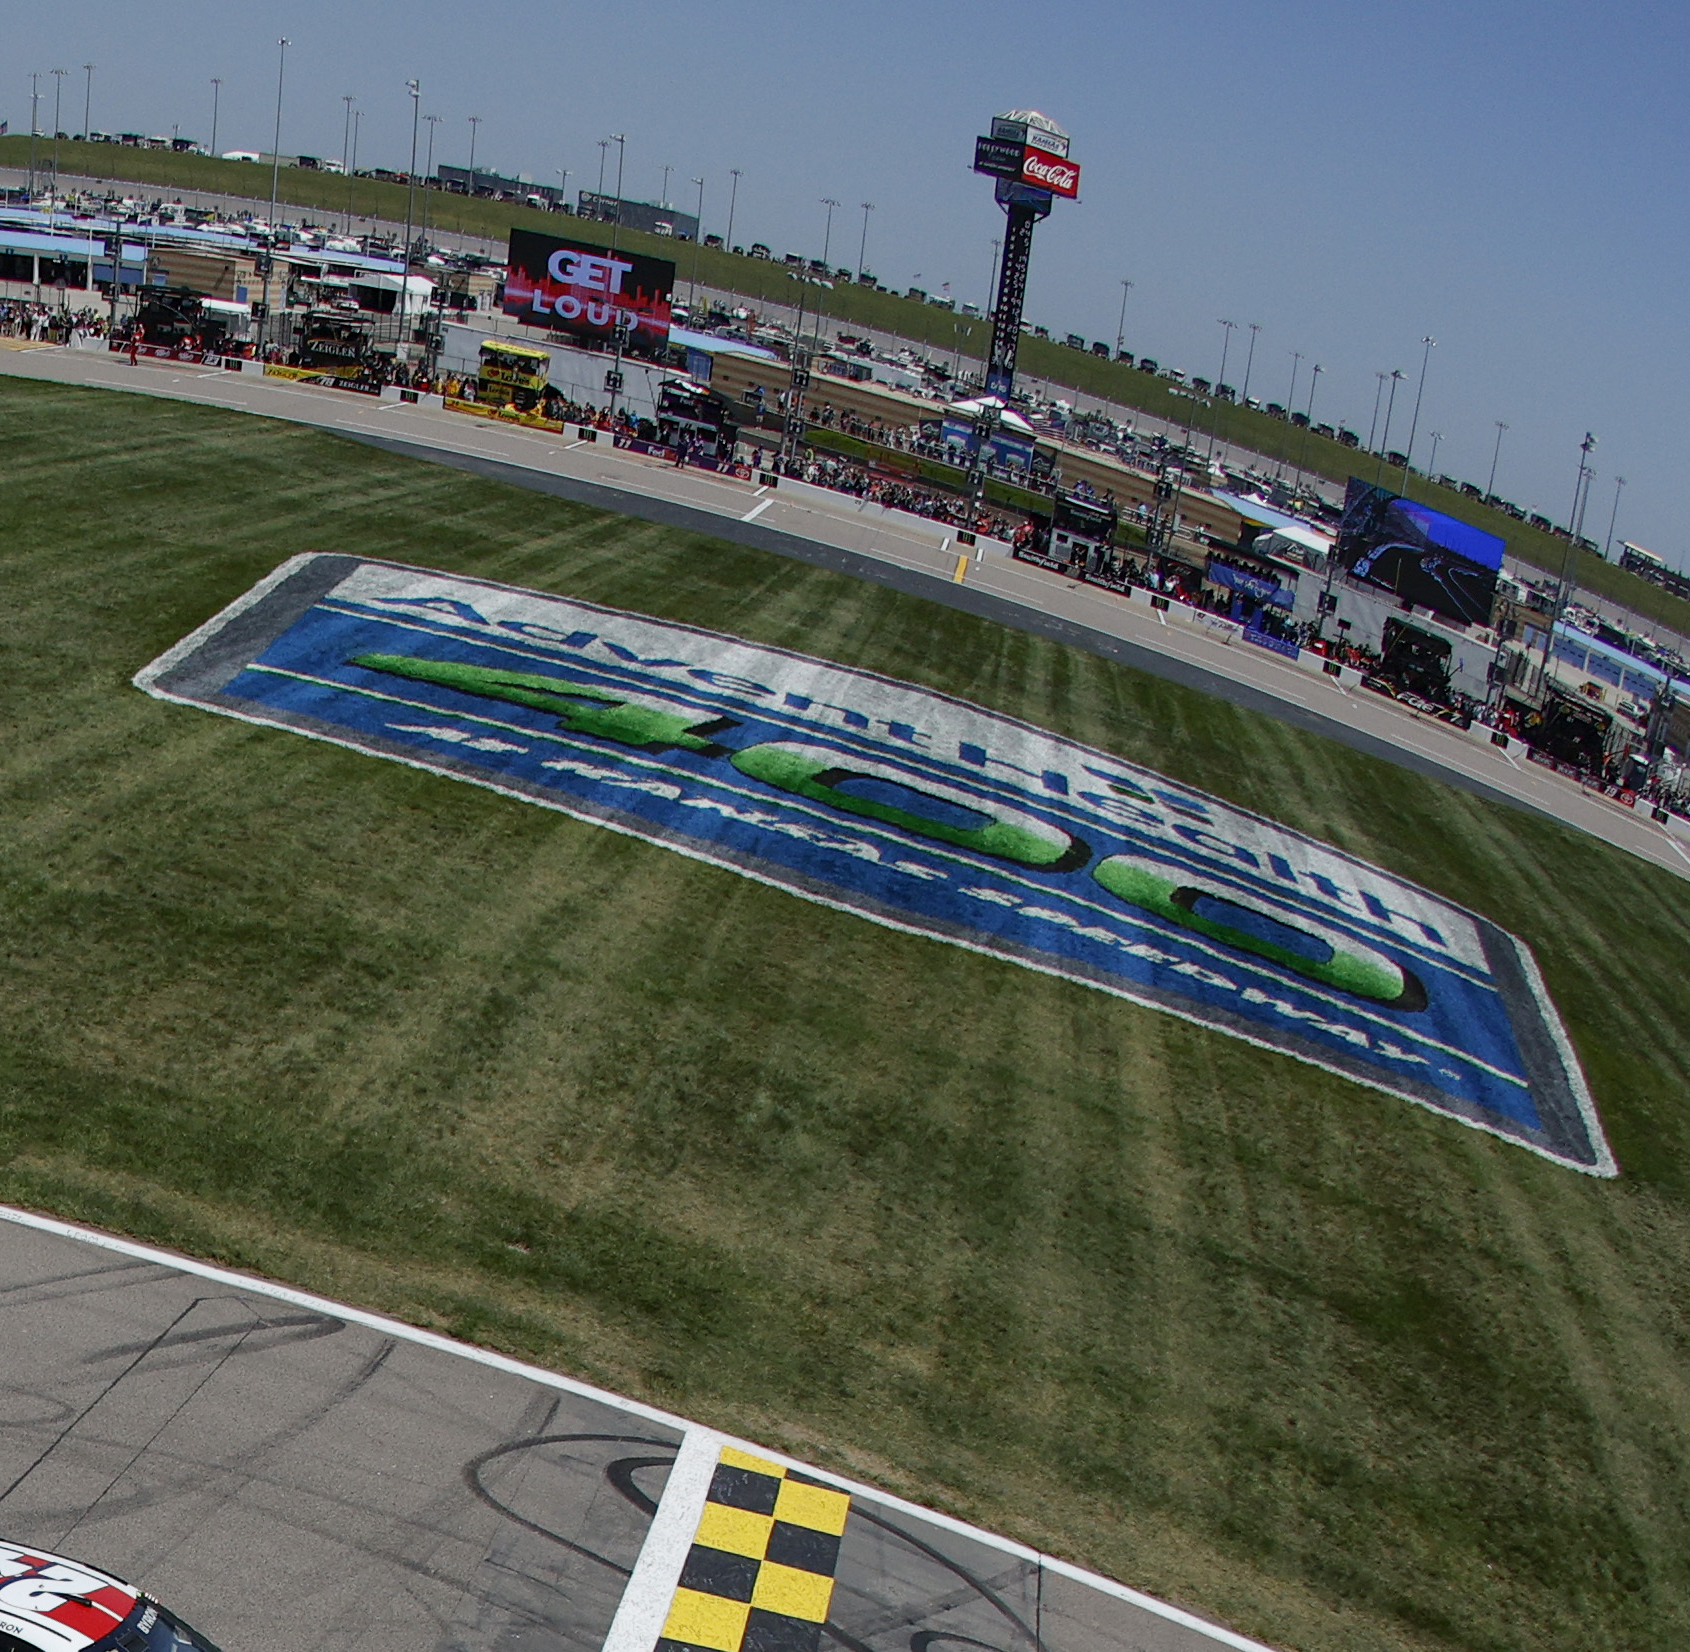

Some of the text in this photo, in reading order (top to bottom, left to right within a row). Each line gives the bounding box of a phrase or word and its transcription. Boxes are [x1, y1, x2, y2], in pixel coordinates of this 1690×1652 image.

[1022, 156, 1075, 189] Coca-Cola
[532, 289, 639, 331] LOUD
[548, 250, 633, 294] GET
[368, 597, 1451, 949] AdventHealth
[345, 652, 1428, 1012] 400
[957, 884, 1431, 1064] SPEEDWAY
